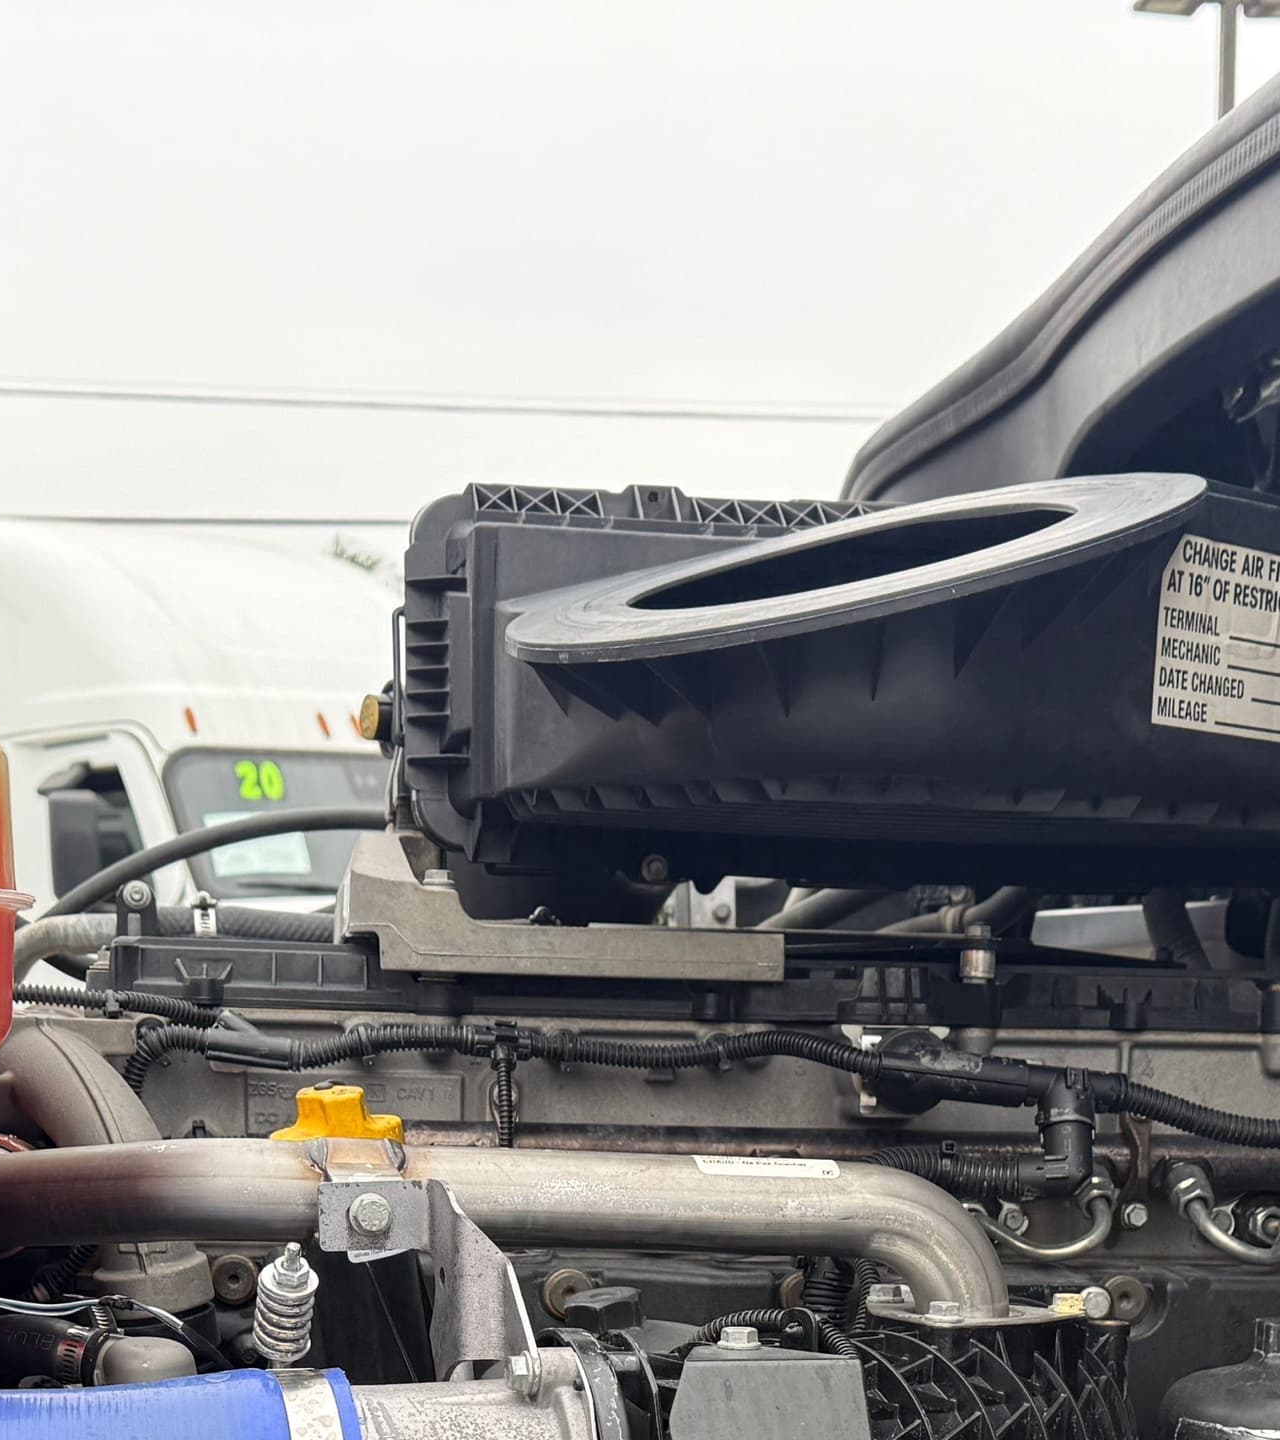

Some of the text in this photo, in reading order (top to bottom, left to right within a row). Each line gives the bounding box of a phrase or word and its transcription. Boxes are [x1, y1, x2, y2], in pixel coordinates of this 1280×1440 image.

[1183, 541, 1236, 574] CHANGE
[1242, 552, 1265, 577] AIR
[1168, 569, 1186, 592] AT
[1213, 578, 1231, 602] OF
[1163, 606, 1220, 636] TERMINAL
[1161, 637, 1221, 666] MECHANIC
[1159, 666, 1245, 700] DATE CHANGED
[1157, 696, 1207, 722] MILEAGE
[234, 759, 285, 801] 20
